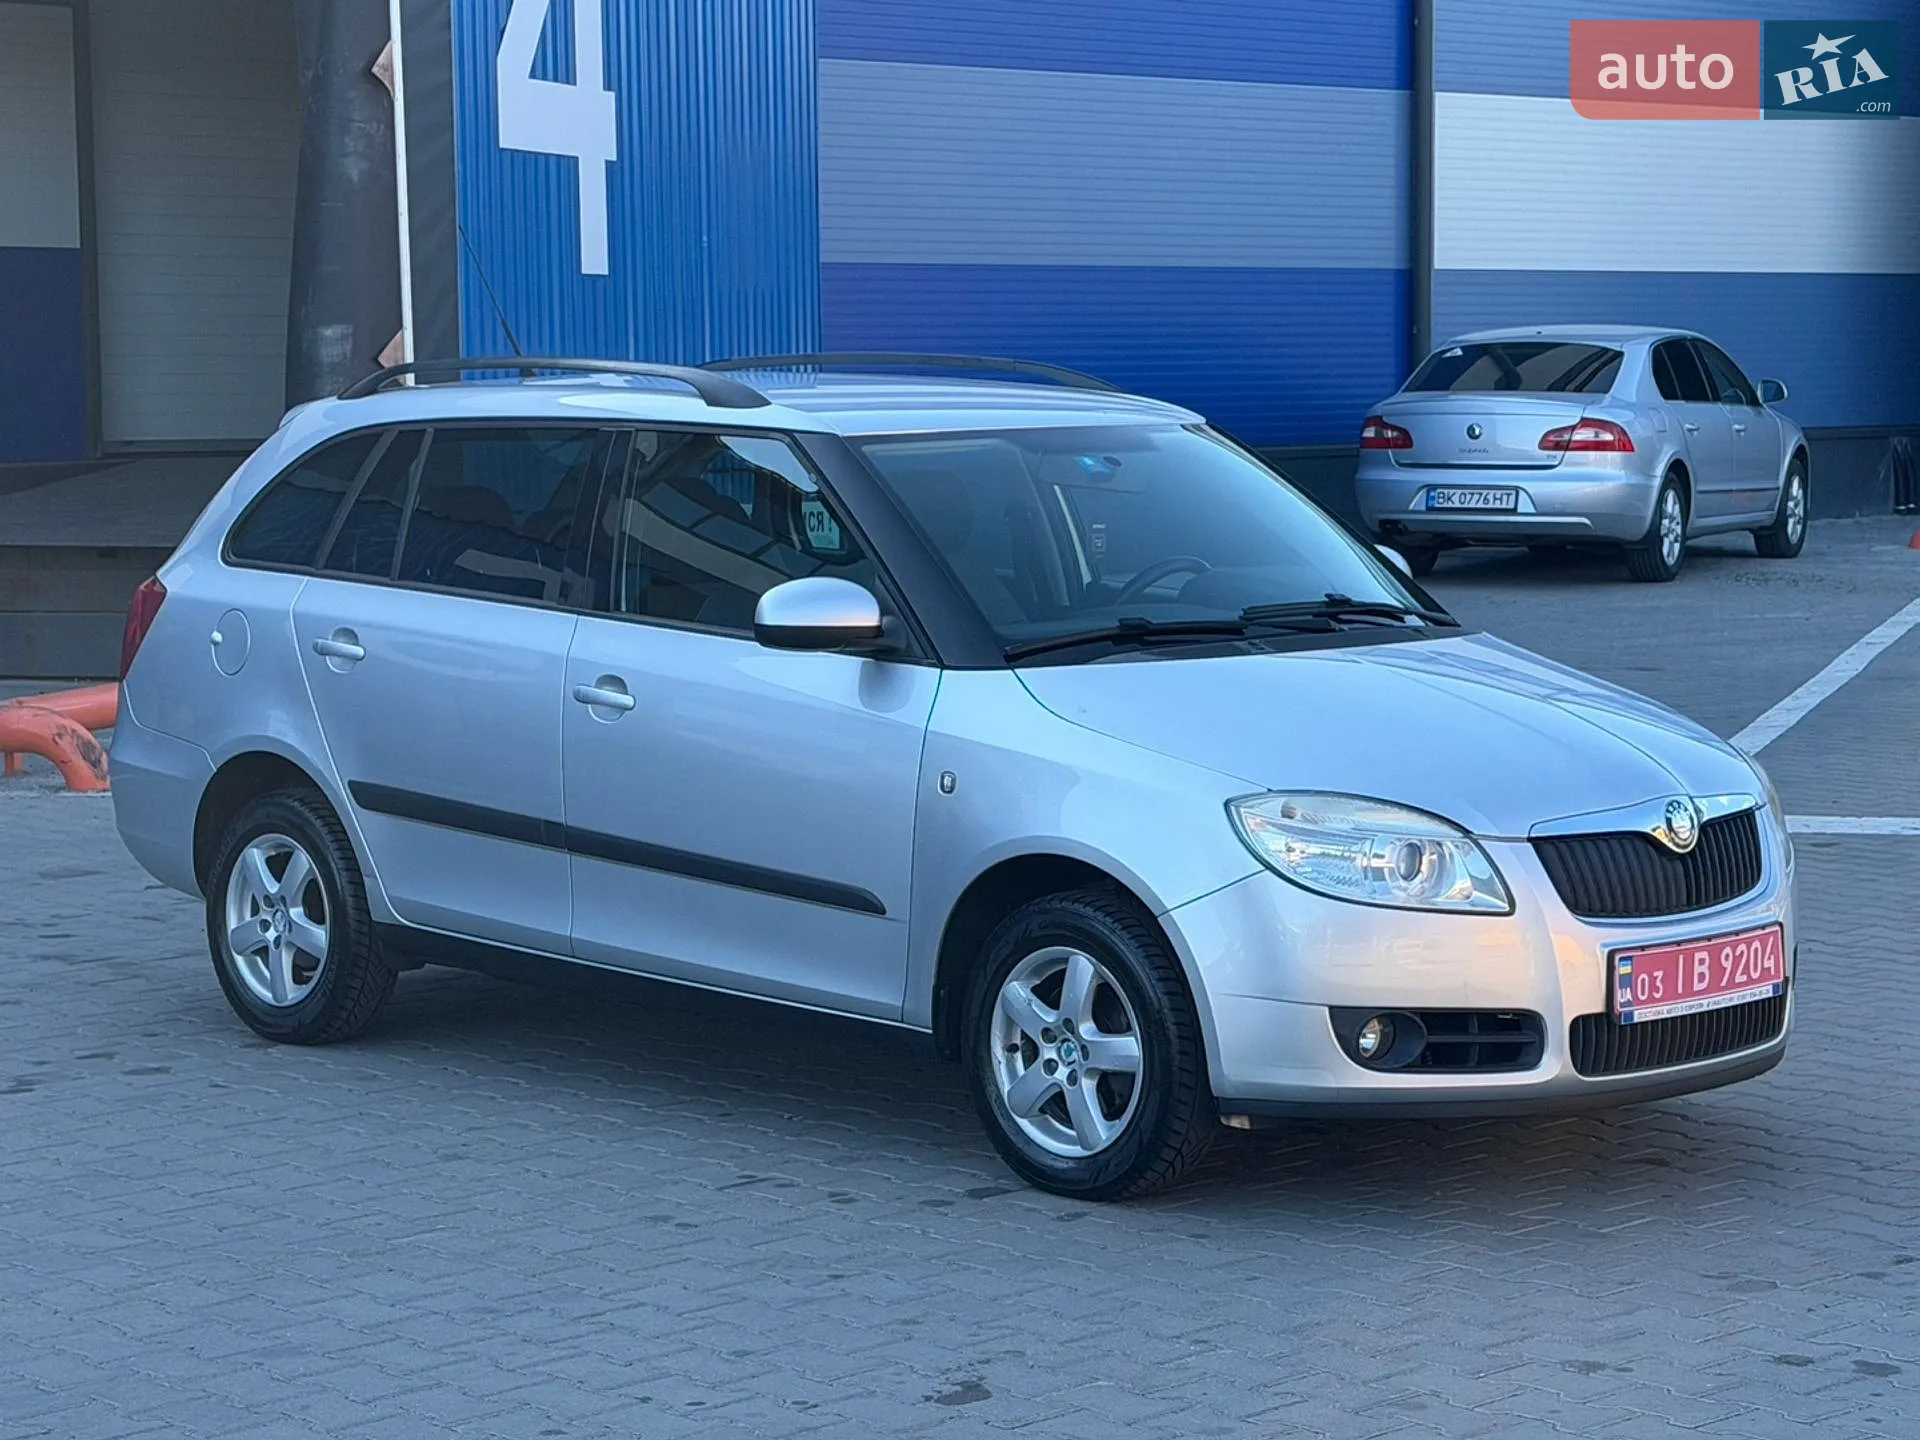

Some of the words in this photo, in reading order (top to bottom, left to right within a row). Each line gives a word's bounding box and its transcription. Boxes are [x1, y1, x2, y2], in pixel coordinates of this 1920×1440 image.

[497, 0, 616, 275] 4
[1437, 490, 1456, 505] BK
[1458, 491, 1490, 505] 0776
[1492, 491, 1513, 506] HT
[1637, 970, 1664, 1001] 03
[1677, 951, 1710, 994] IB
[1720, 936, 1775, 987] 9204
[1618, 987, 1633, 1003] UA
